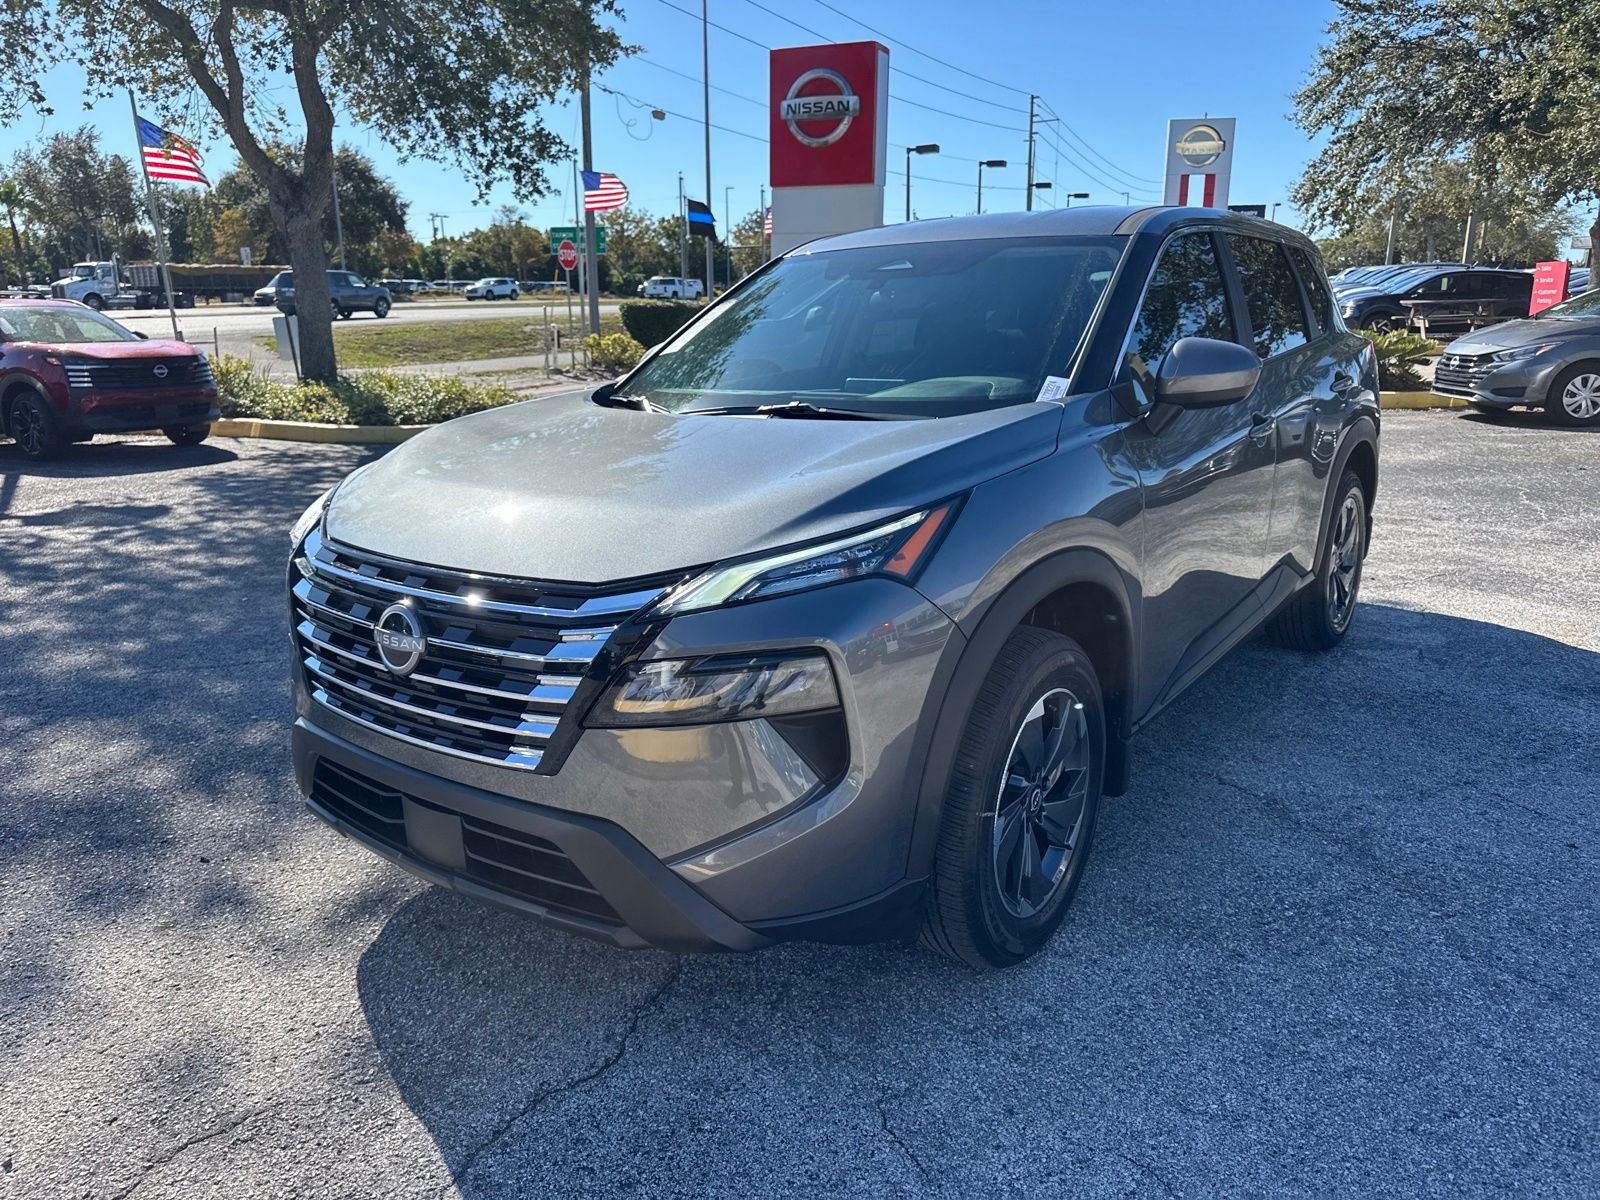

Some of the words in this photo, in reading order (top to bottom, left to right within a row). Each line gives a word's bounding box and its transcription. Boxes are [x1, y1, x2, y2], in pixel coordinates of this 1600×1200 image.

[786, 100, 850, 116] NISSAN
[560, 249, 576, 260] STOP
[375, 629, 423, 650] NISSAN
